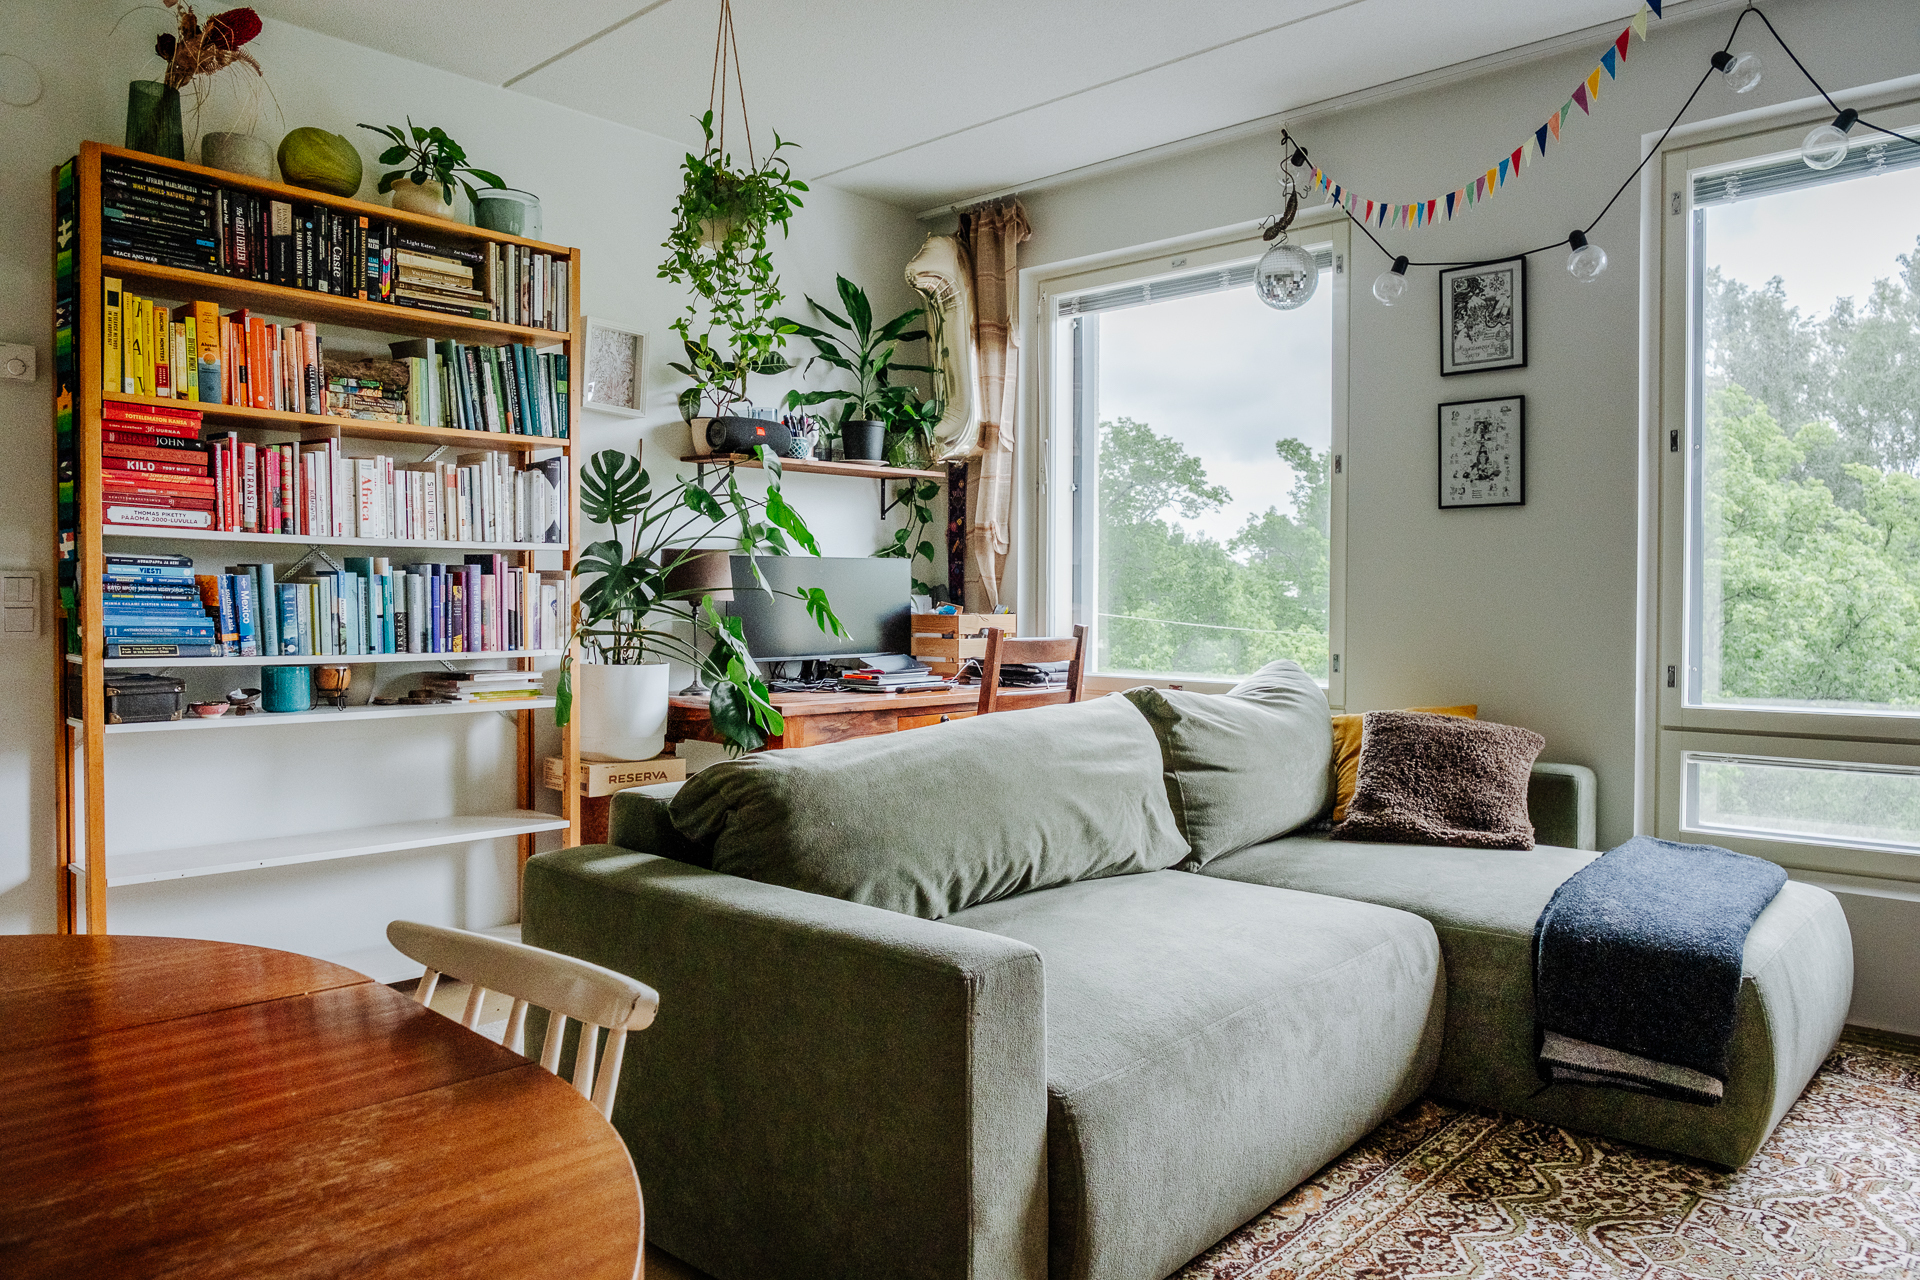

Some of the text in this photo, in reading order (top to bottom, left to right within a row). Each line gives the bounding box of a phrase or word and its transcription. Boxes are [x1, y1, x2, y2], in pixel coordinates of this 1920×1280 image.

[235, 217, 245, 236] GREAT
[112, 250, 130, 258] PEACE
[333, 246, 343, 277] Caste
[125, 413, 167, 423] TOTTELEMATON
[156, 437, 185, 447] JOHN
[127, 461, 155, 471] KILO
[344, 477, 354, 512] Sapiens
[362, 475, 373, 522] Africa
[474, 585, 479, 594] WE
[241, 590, 250, 624] Mexico
[474, 613, 479, 622] NO
[608, 770, 668, 784] RESERVA
